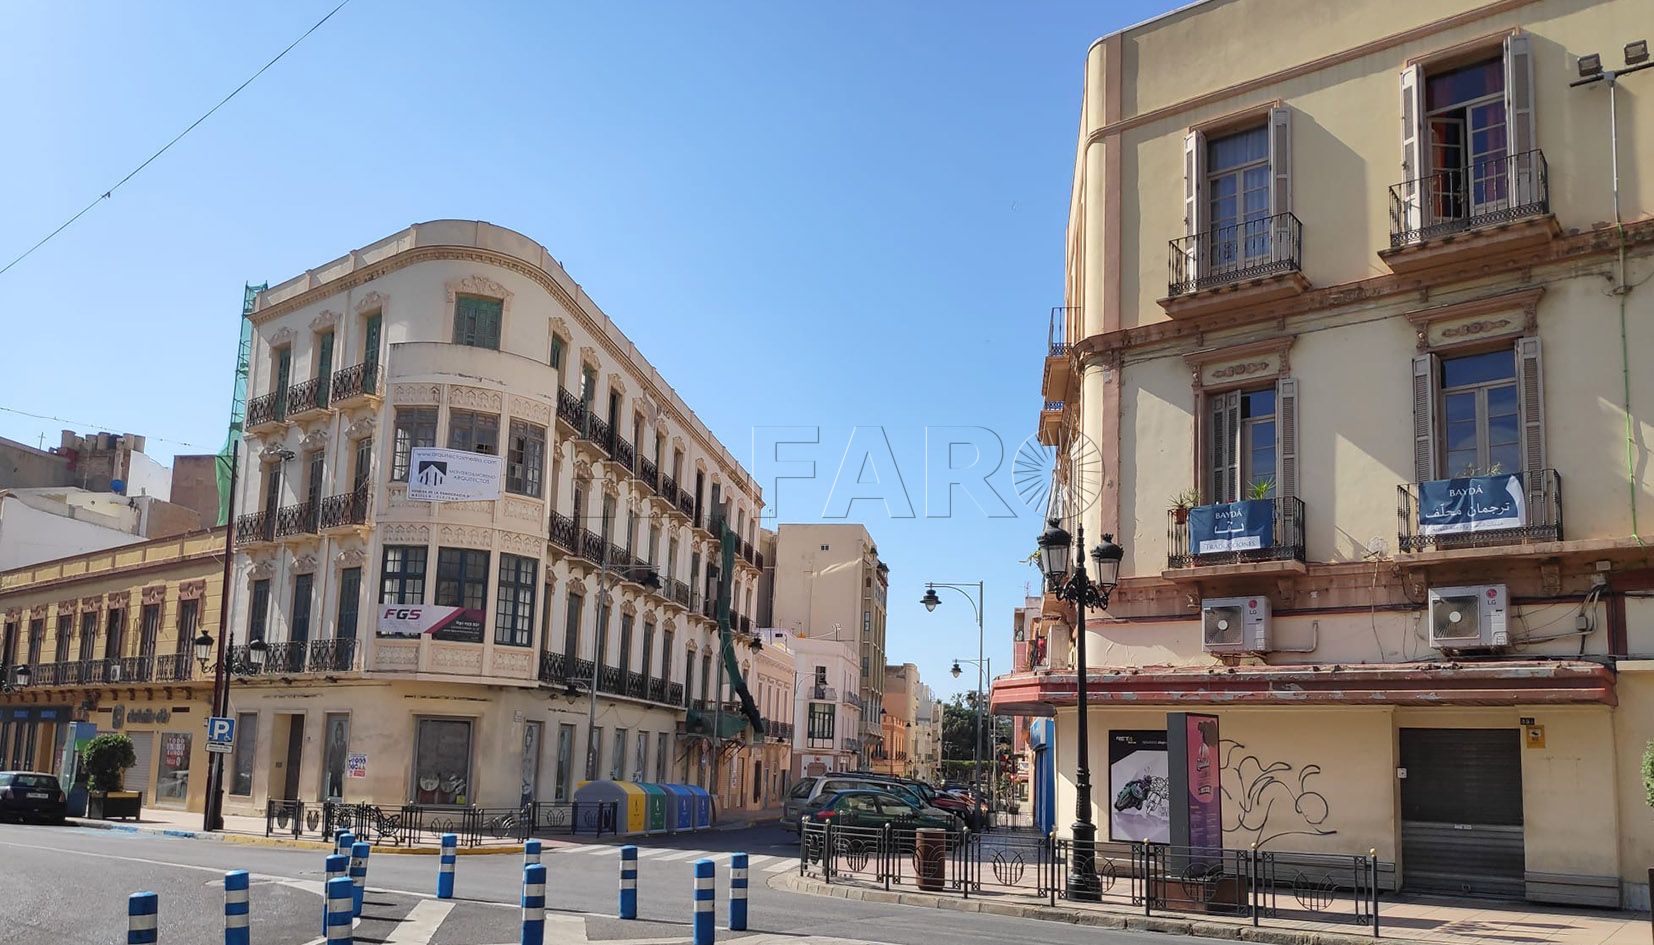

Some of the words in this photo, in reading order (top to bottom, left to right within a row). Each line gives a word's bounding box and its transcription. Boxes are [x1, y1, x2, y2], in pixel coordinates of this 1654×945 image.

[1449, 485, 1484, 497] BAYDÁ
[1215, 508, 1243, 519] BAYDÁ
[384, 609, 422, 620] FGS
[213, 720, 230, 740] P
